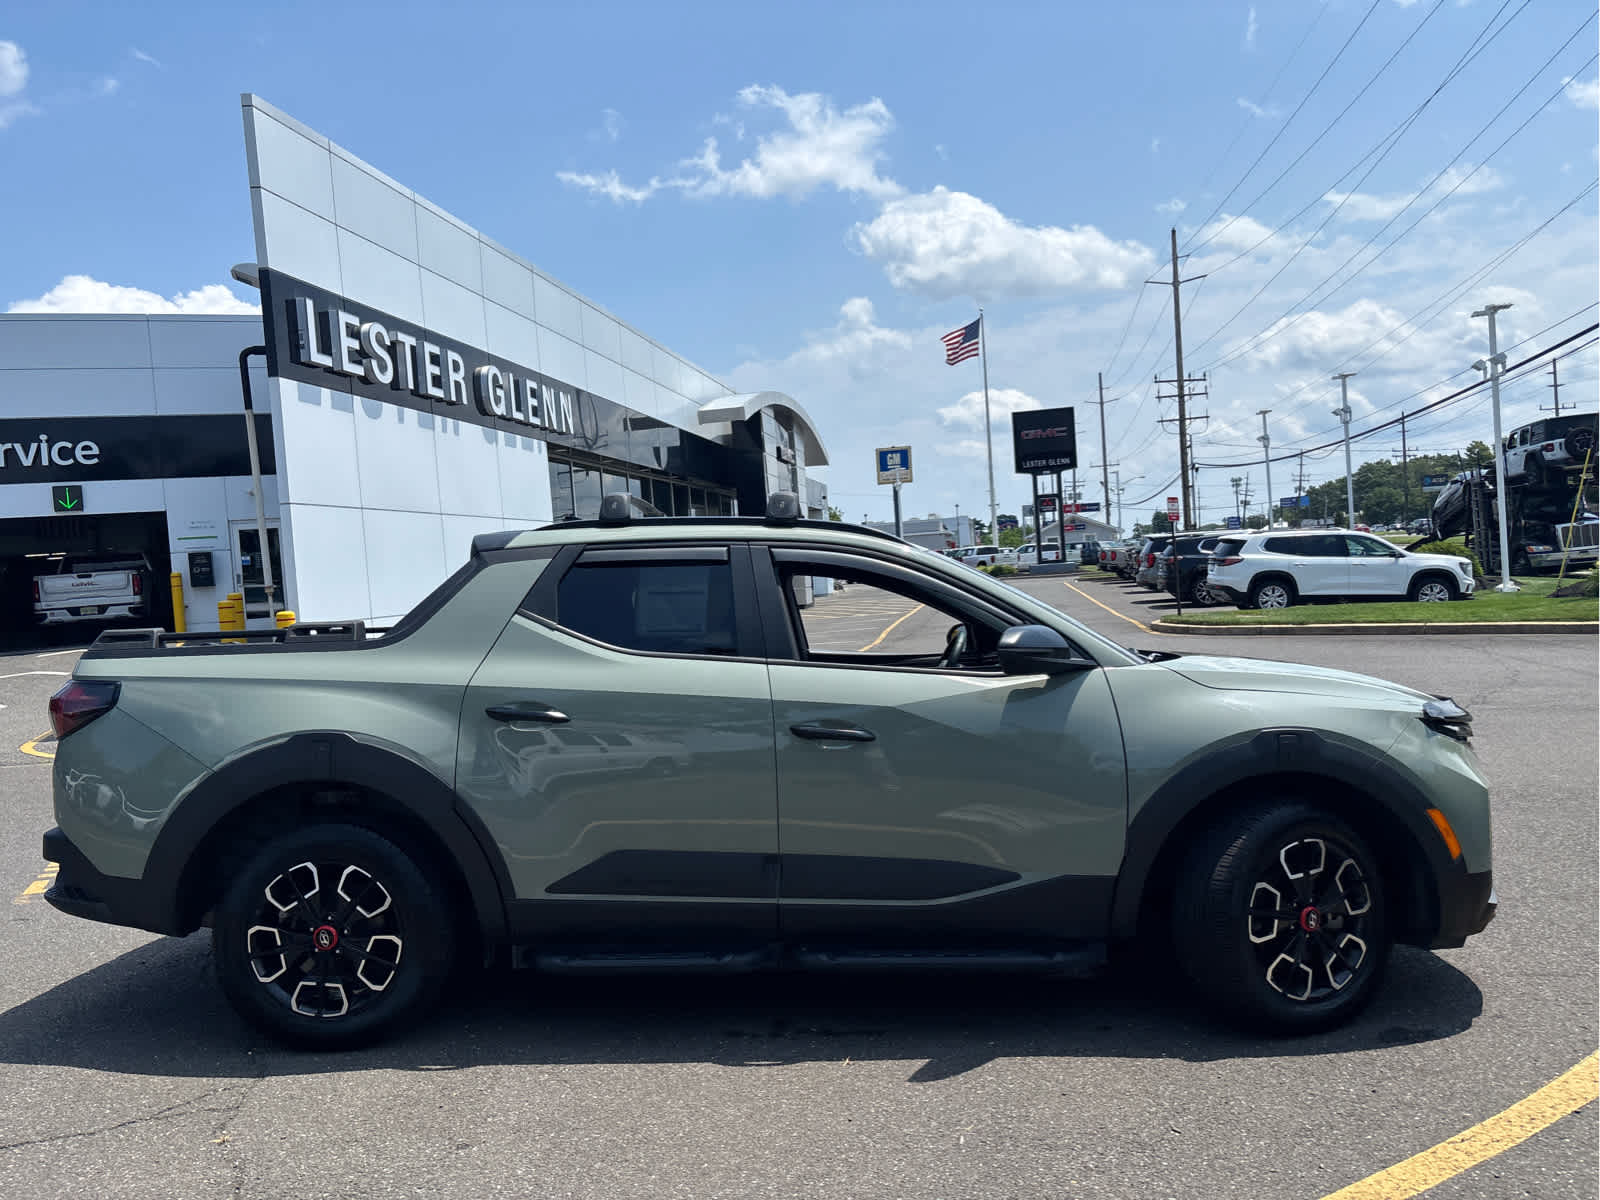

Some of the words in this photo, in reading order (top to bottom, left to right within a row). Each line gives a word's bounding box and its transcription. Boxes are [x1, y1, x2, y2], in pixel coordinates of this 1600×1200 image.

[296, 297, 468, 405] LESTER
[475, 365, 575, 434] GLENN
[1022, 459, 1047, 468] LESTER
[1048, 457, 1070, 466] GLENN
